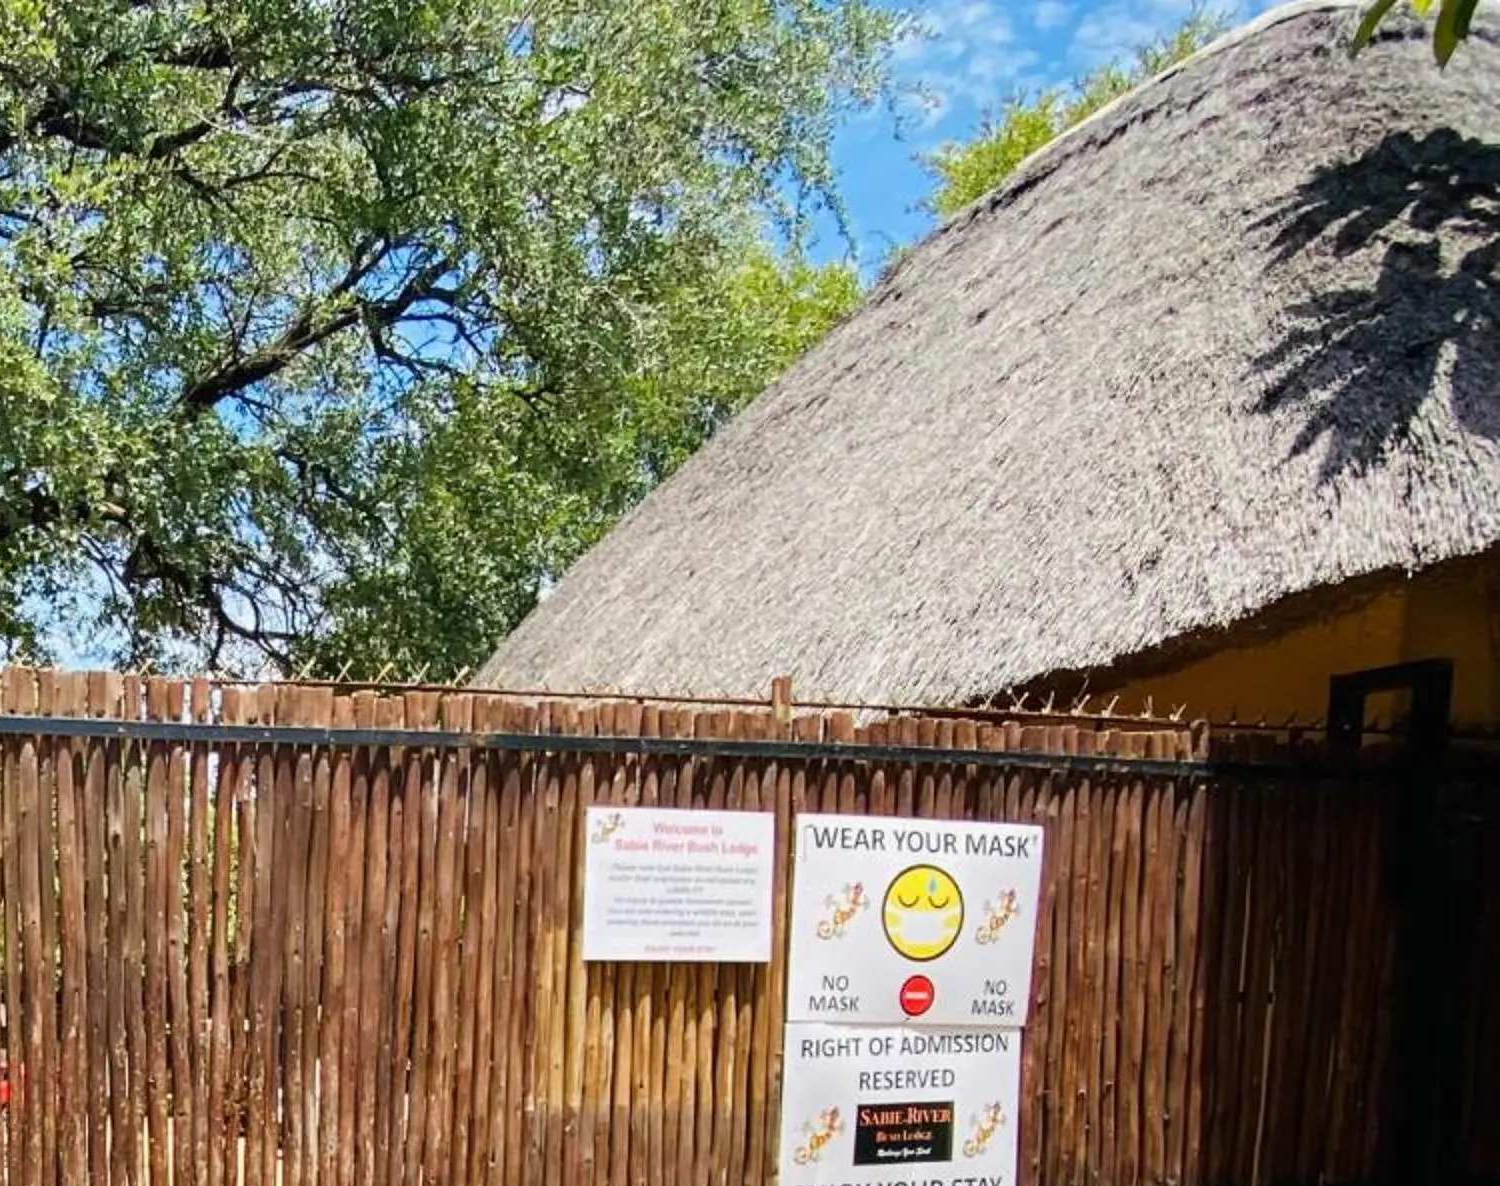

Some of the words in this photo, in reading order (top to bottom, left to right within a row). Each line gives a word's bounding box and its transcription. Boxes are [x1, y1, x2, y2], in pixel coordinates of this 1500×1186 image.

[654, 822, 708, 835] Welcome
[711, 824, 723, 835] to
[652, 840, 685, 852] River
[813, 826, 885, 851] WEAR
[893, 830, 957, 854] YOUR
[965, 834, 1029, 859] MASK
[822, 975, 849, 991] NO
[983, 979, 1007, 996] NO
[809, 995, 859, 1012] MASK
[971, 999, 1015, 1016] MASK
[801, 1037, 862, 1059] RIGHT
[869, 1037, 894, 1056] OF
[900, 1033, 1009, 1056] ADMISSION
[859, 1069, 955, 1091] RESERVED
